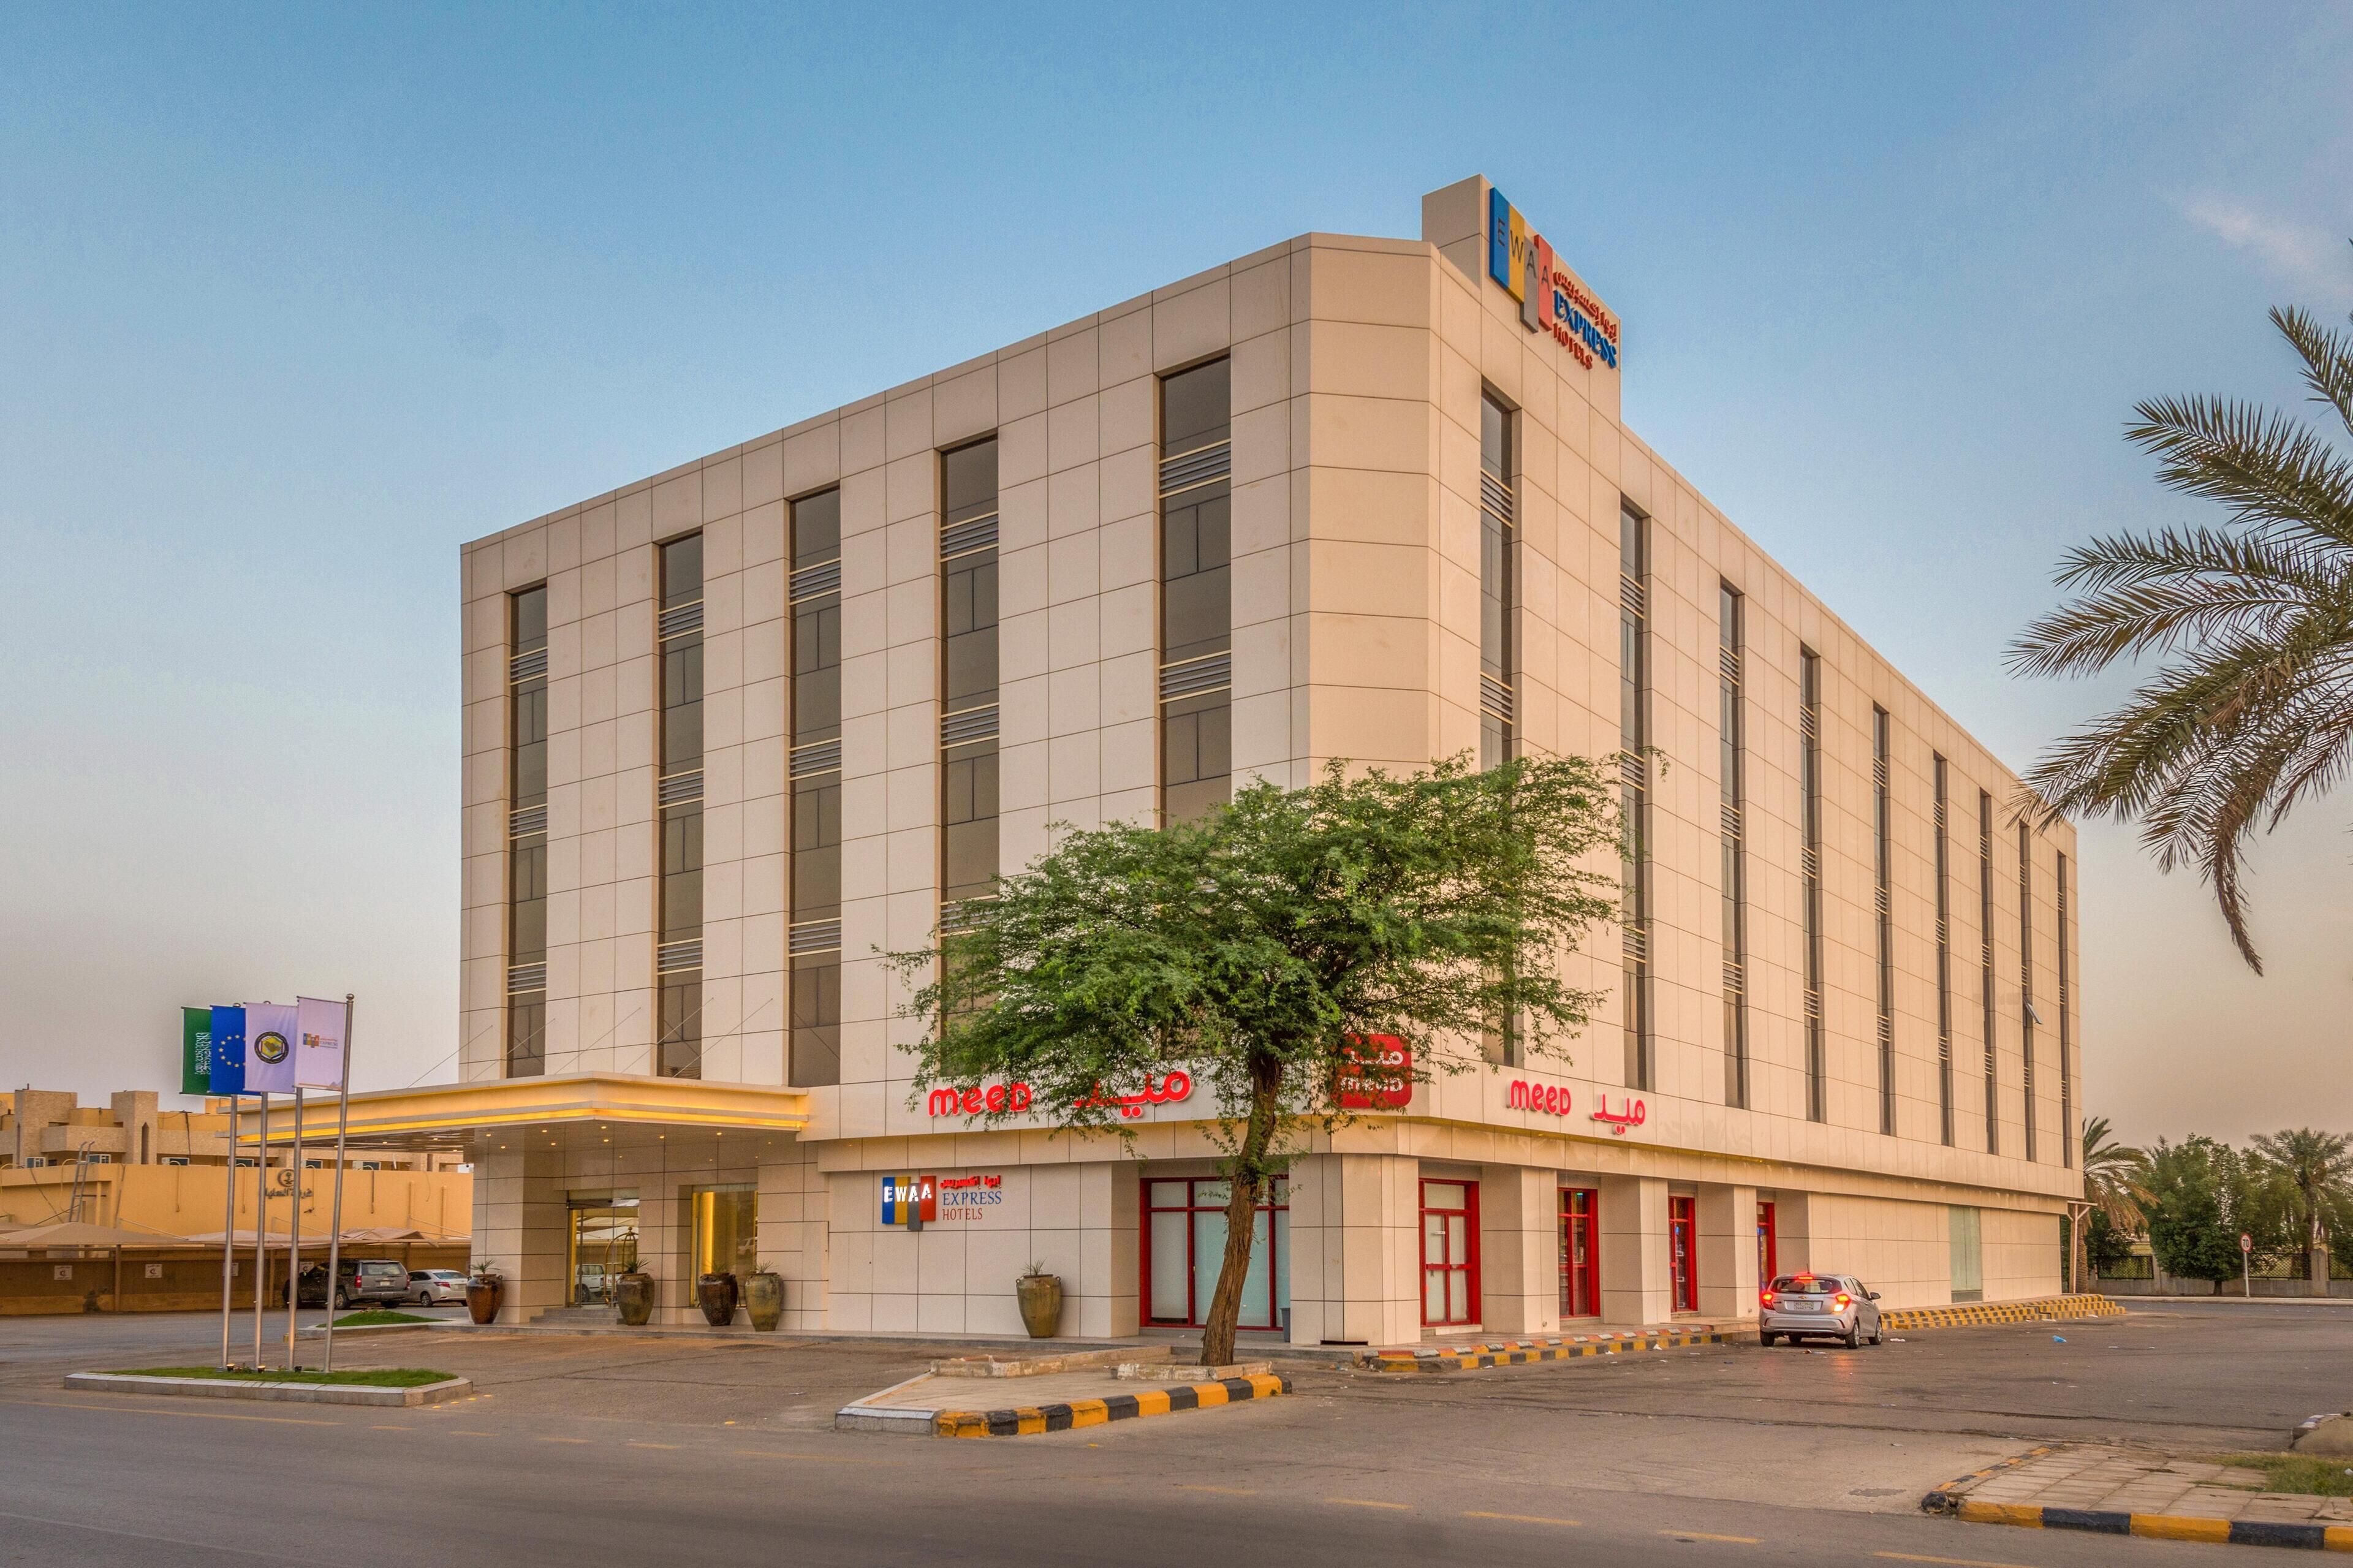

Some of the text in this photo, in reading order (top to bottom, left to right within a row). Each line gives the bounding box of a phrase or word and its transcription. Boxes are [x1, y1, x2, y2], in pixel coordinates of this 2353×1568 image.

[1498, 217, 1550, 292] EWAA
[1553, 289, 1617, 369] EXPRESS
[1553, 323, 1593, 369] HOTELS
[1073, 1071, 1191, 1118] ميد
[1593, 1094, 1646, 1134] ميد
[884, 1184, 932, 1203] EWAA
[942, 1191, 1002, 1206] EXPRESS
[942, 1208, 983, 1221] HOTELS
[2242, 1238, 2249, 1248] 70
